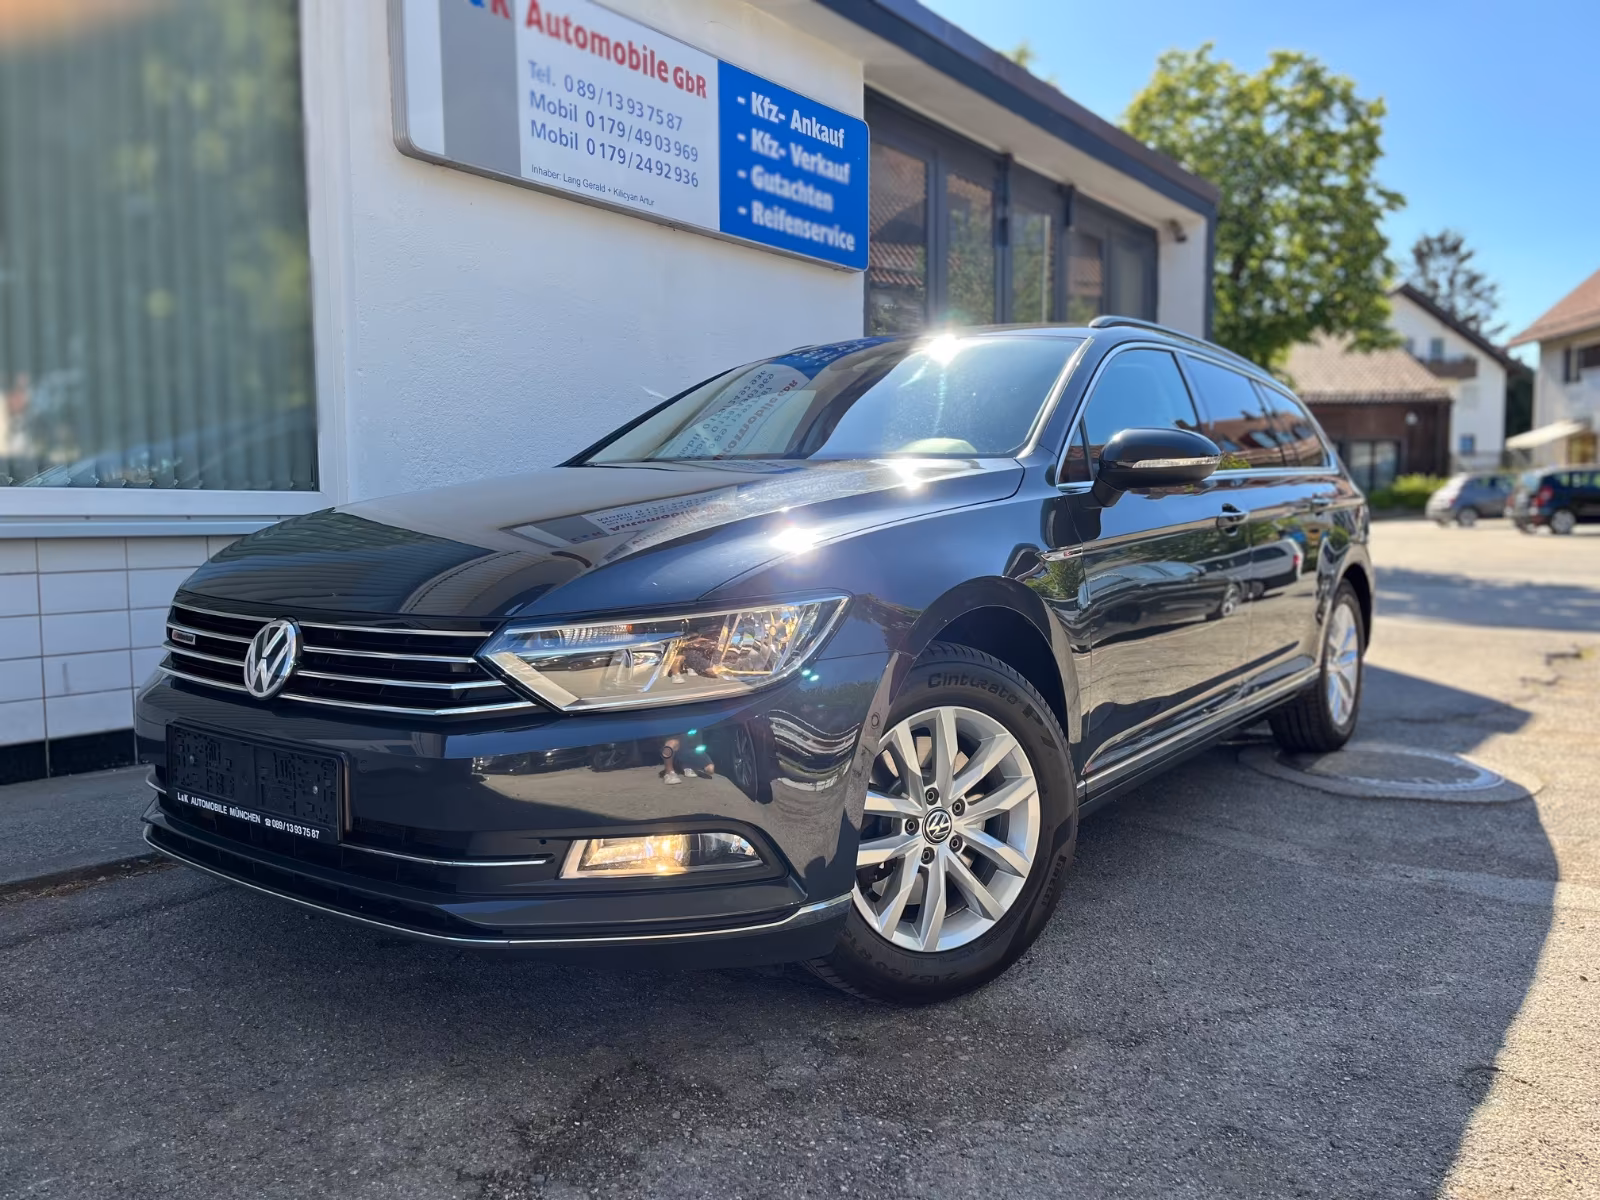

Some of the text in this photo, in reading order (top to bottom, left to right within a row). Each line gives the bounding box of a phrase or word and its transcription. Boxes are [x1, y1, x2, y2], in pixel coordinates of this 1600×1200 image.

[525, 0, 707, 99] Automobile GbR
[528, 59, 556, 87] Tel.
[530, 89, 578, 122] Mobil
[531, 119, 579, 151] Mobil
[790, 109, 845, 149] Ankauf
[531, 164, 561, 181] Inhaber:
[563, 173, 581, 187] Lang
[582, 178, 606, 193] Gerald
[790, 142, 851, 185] Verkauf
[751, 164, 835, 213] Gutachten
[751, 200, 856, 252] Reifenservice
[928, 672, 1018, 705] Cinturato
[190, 796, 228, 815] AUTOMOBILE
[229, 806, 261, 824] MÜNCHEN
